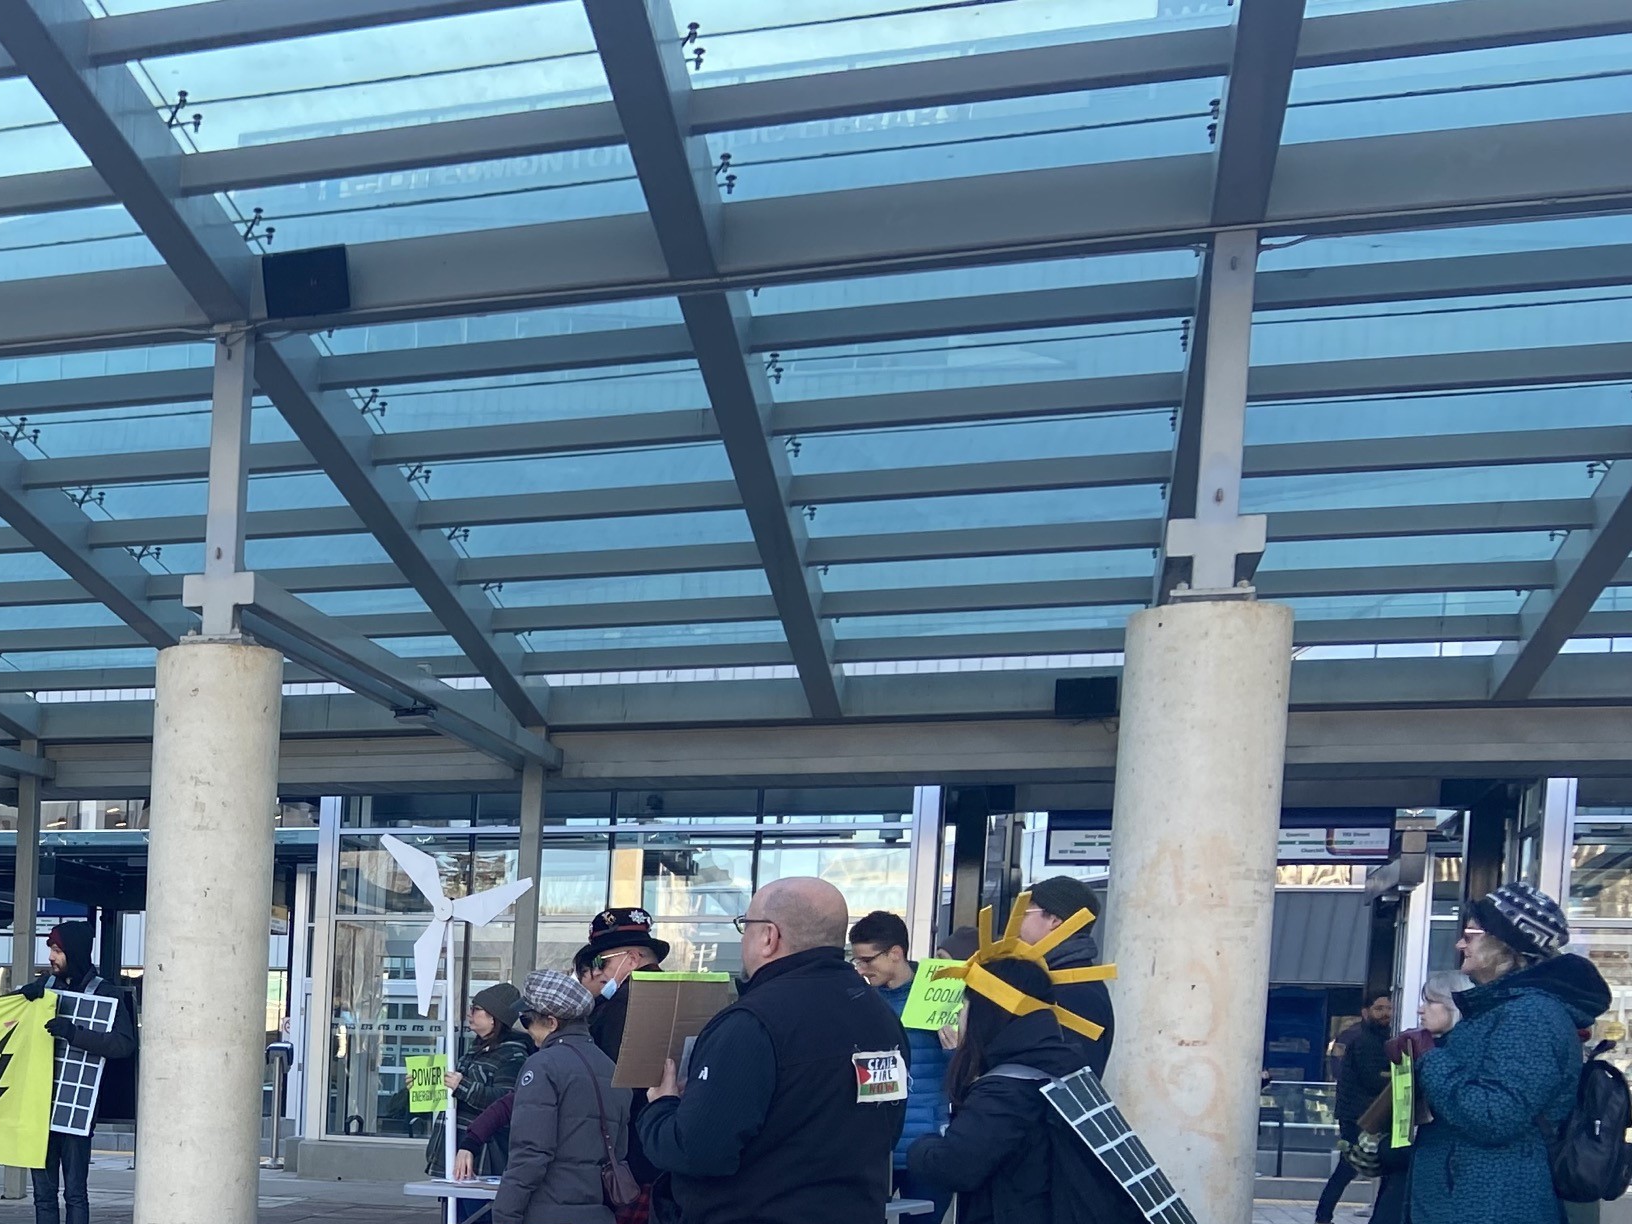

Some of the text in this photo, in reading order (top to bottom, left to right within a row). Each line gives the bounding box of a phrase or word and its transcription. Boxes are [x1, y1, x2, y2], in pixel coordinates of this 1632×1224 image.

[923, 987, 963, 1003] COOLI
[925, 1010, 959, 1026] A RIG
[429, 1024, 442, 1032] ETS
[412, 1066, 442, 1087] POWER
[873, 1070, 893, 1082] FIRE
[869, 1082, 895, 1094] NOW
